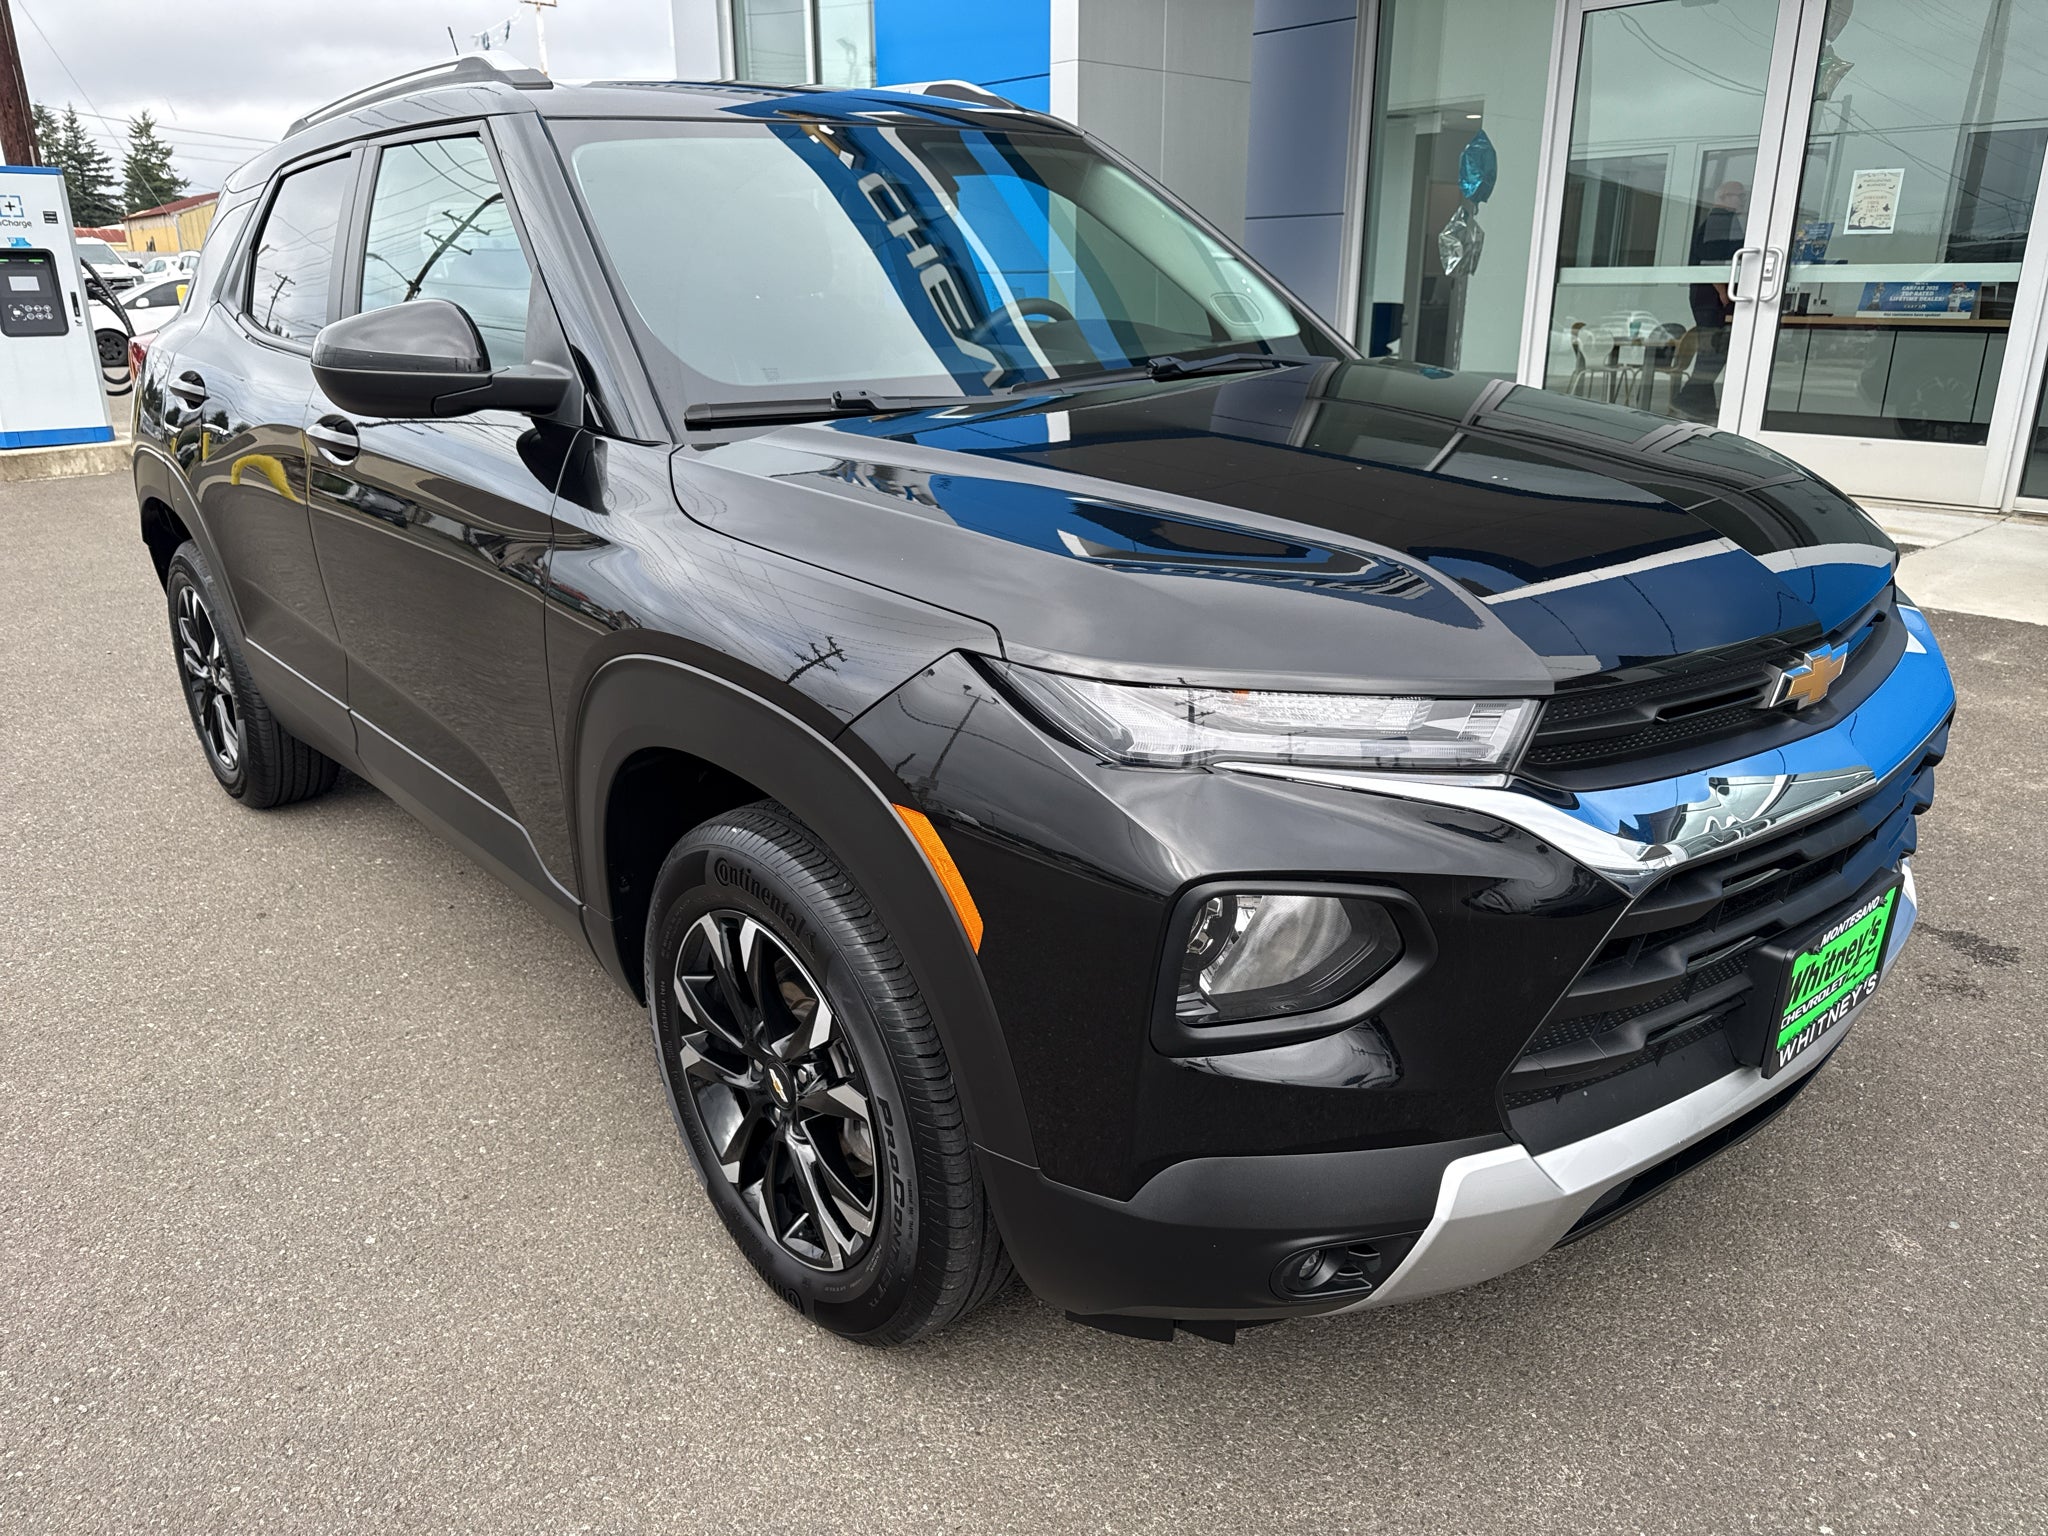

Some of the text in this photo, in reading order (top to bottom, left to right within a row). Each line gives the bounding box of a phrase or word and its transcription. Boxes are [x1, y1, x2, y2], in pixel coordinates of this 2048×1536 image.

[714, 857, 806, 938] Continental
[1821, 895, 1880, 947] MONTESANO
[1790, 916, 1882, 1004] Whitney's
[1779, 974, 1878, 1067] WHITNEY'S
[1781, 975, 1847, 1029] CHEVROLET
